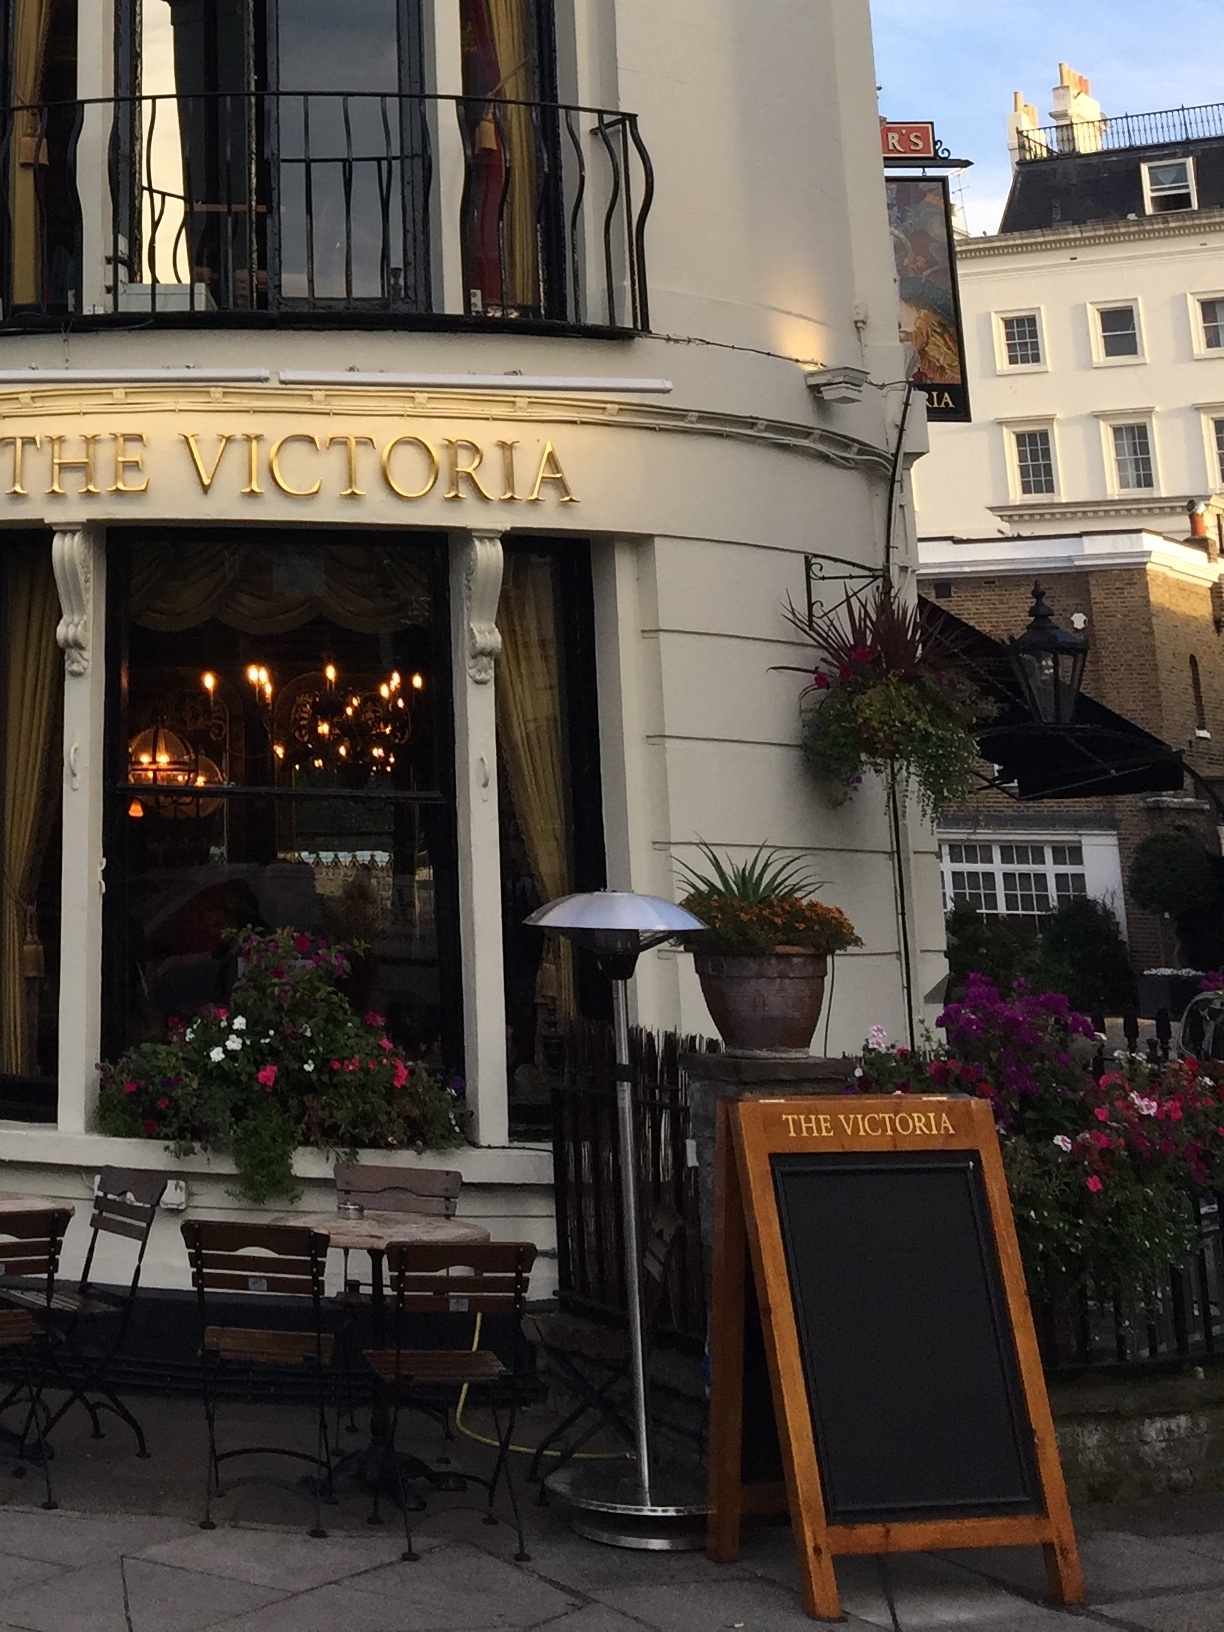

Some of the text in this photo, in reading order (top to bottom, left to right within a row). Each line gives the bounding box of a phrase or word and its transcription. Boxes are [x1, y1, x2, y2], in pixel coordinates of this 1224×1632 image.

[178, 432, 582, 504] VICTORIA
[782, 1112, 955, 1137] THE VICTORIA
